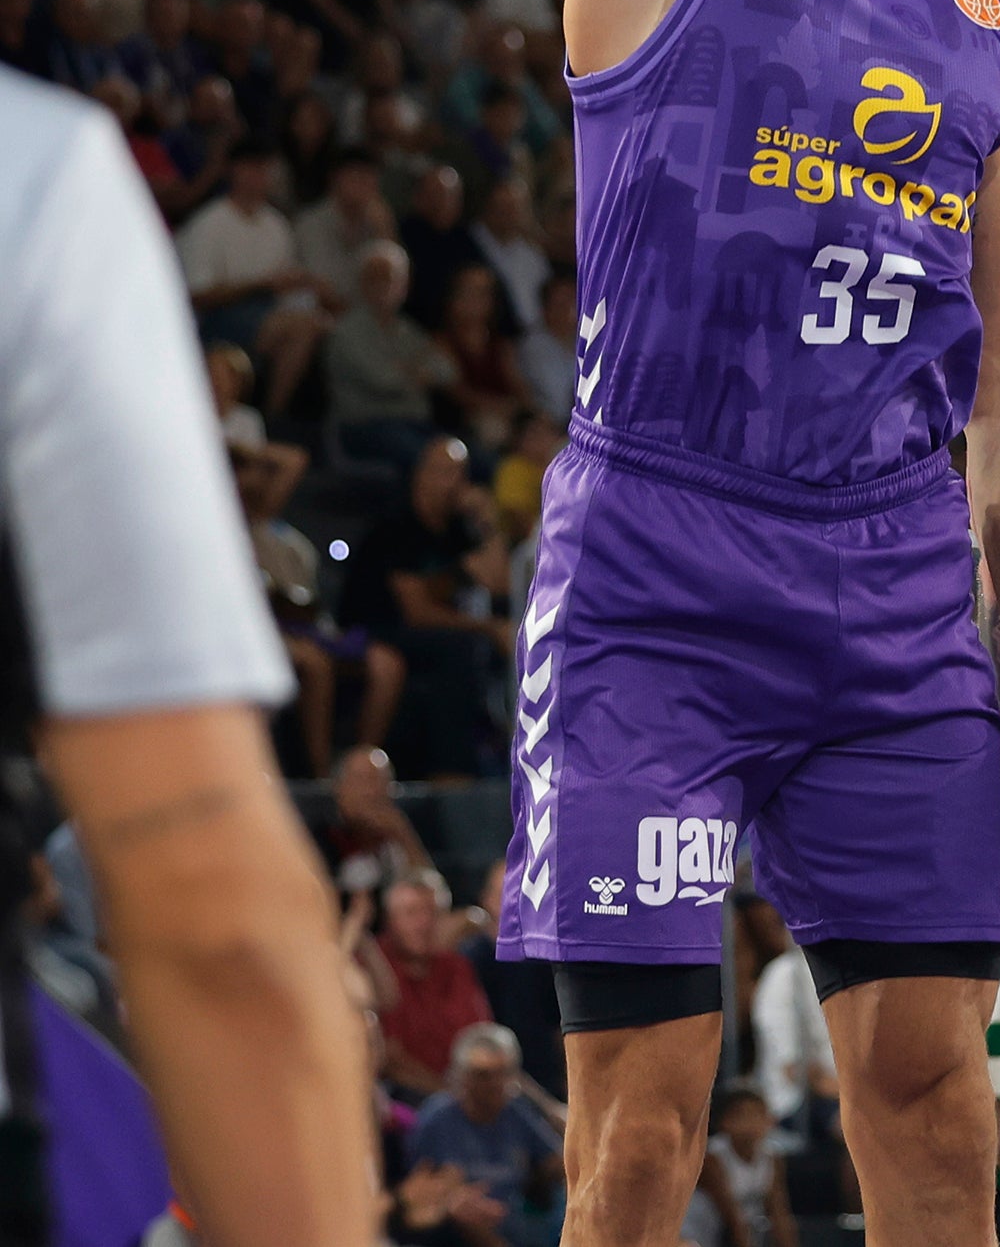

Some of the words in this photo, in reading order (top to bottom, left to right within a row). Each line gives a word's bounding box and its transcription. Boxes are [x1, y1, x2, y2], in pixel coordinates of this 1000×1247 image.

[756, 126, 841, 154] súper
[800, 243, 927, 345] 35
[584, 901, 628, 916] hummel
